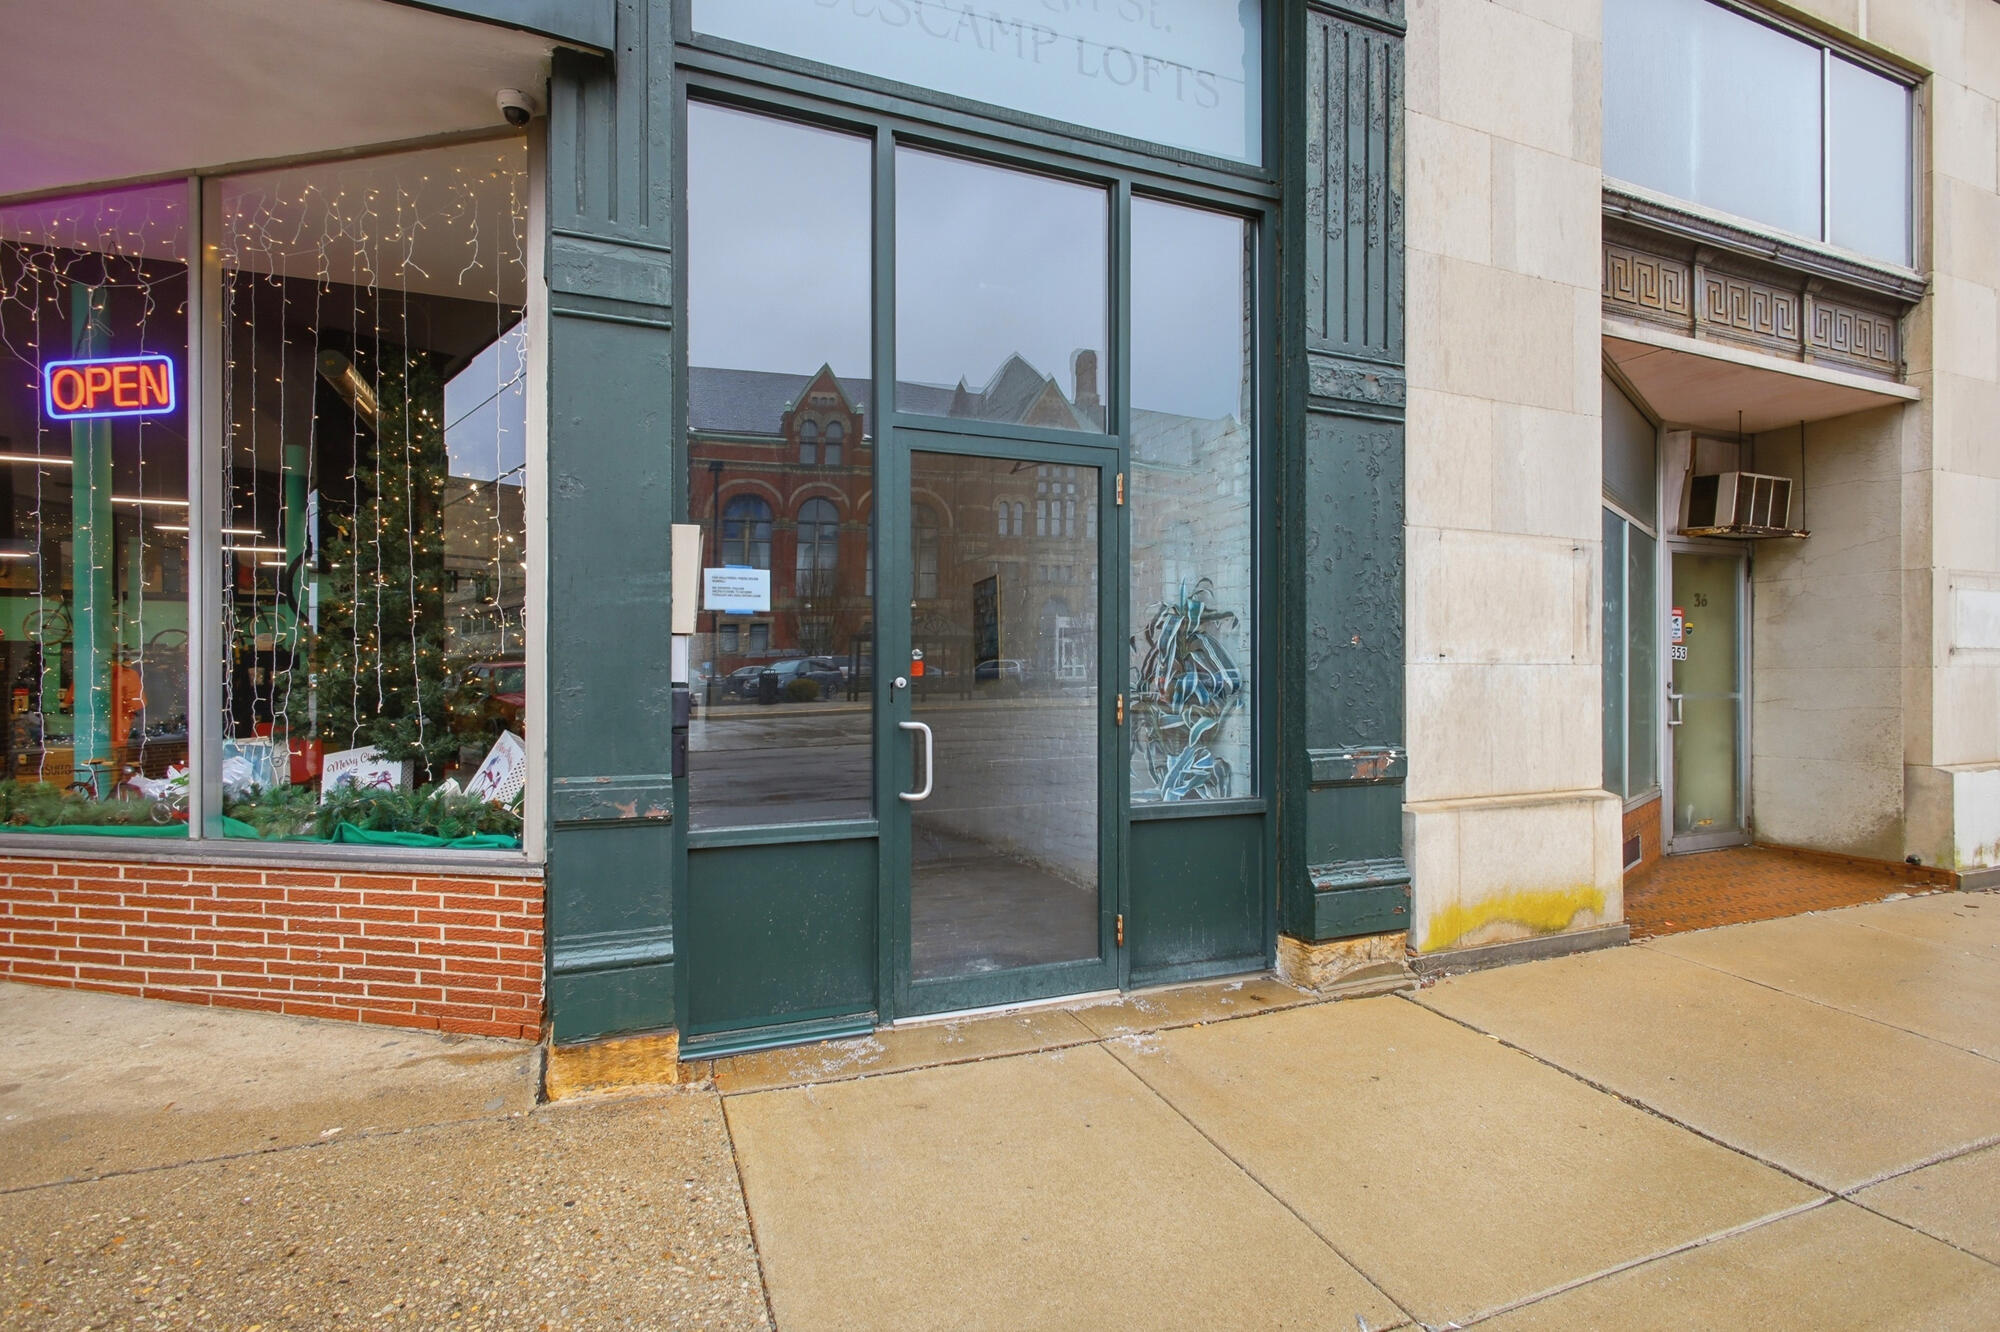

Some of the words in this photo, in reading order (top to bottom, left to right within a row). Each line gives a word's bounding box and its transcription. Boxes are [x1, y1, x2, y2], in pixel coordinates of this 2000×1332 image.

[814, 0, 1057, 64] SCAMP
[1076, 36, 1220, 110] LOFTS
[52, 363, 169, 410] OPEN
[327, 758, 358, 773] Merry
